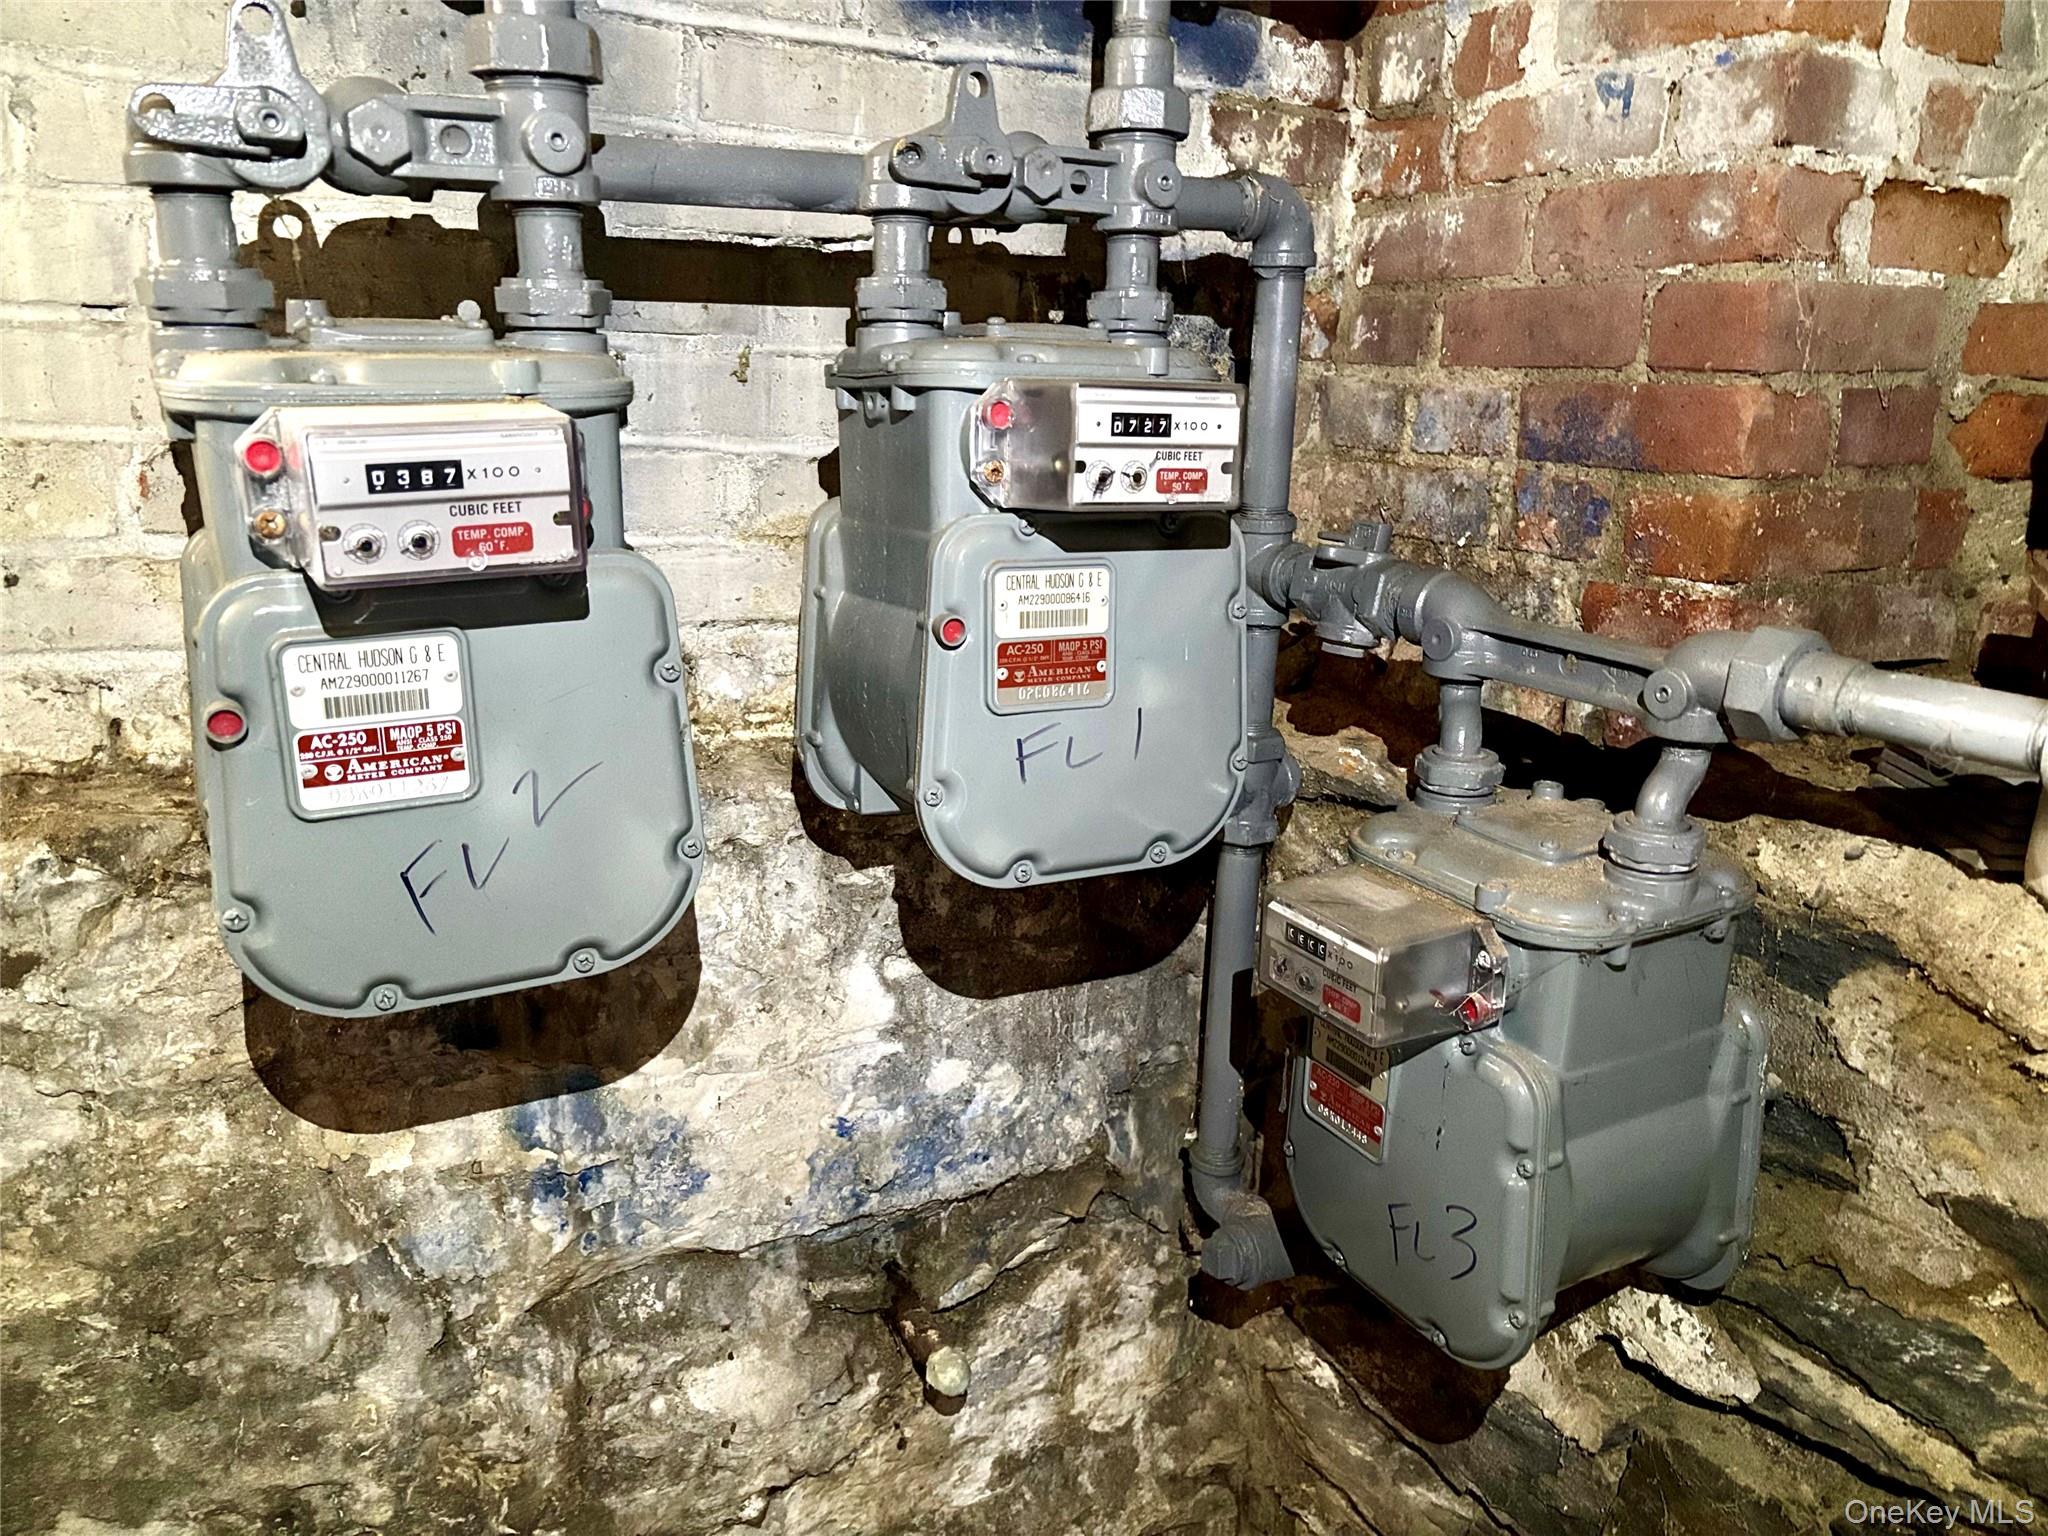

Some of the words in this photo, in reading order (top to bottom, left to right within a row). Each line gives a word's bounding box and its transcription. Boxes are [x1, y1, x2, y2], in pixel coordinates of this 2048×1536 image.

[1113, 418, 1167, 434] 0727
[1155, 451, 1181, 461] CUBIC
[1183, 451, 1203, 461] FEET
[370, 467, 457, 487] 0387
[1182, 471, 1205, 481] COMP.
[449, 503, 489, 517] CUBIC
[493, 501, 522, 514] FEET
[457, 528, 491, 541] TEMP.
[493, 526, 529, 539] COMP.
[1006, 574, 1041, 591] CENTRAL
[1045, 572, 1075, 589] HUDSON
[1078, 572, 1084, 588] G
[1097, 571, 1103, 587] E
[1006, 643, 1044, 656] AC-250
[1058, 641, 1081, 653] MAOP
[1082, 640, 1088, 651] 5
[1089, 639, 1103, 650] PSI
[297, 652, 352, 673] CENTRAL
[358, 647, 403, 668] HUDSON
[409, 645, 418, 664] G
[437, 643, 446, 662] E
[320, 668, 429, 690] AM229000011267
[310, 731, 367, 750] AC-250
[389, 725, 423, 741] MAOP
[426, 724, 433, 737] 5
[436, 721, 457, 736] PSI
[1016, 722, 1103, 785] FL
[347, 770, 387, 781] METER
[390, 764, 444, 776] COMPANY
[512, 761, 604, 828] 2
[1388, 1202, 1436, 1267] FL
[1445, 1204, 1478, 1280] 3
